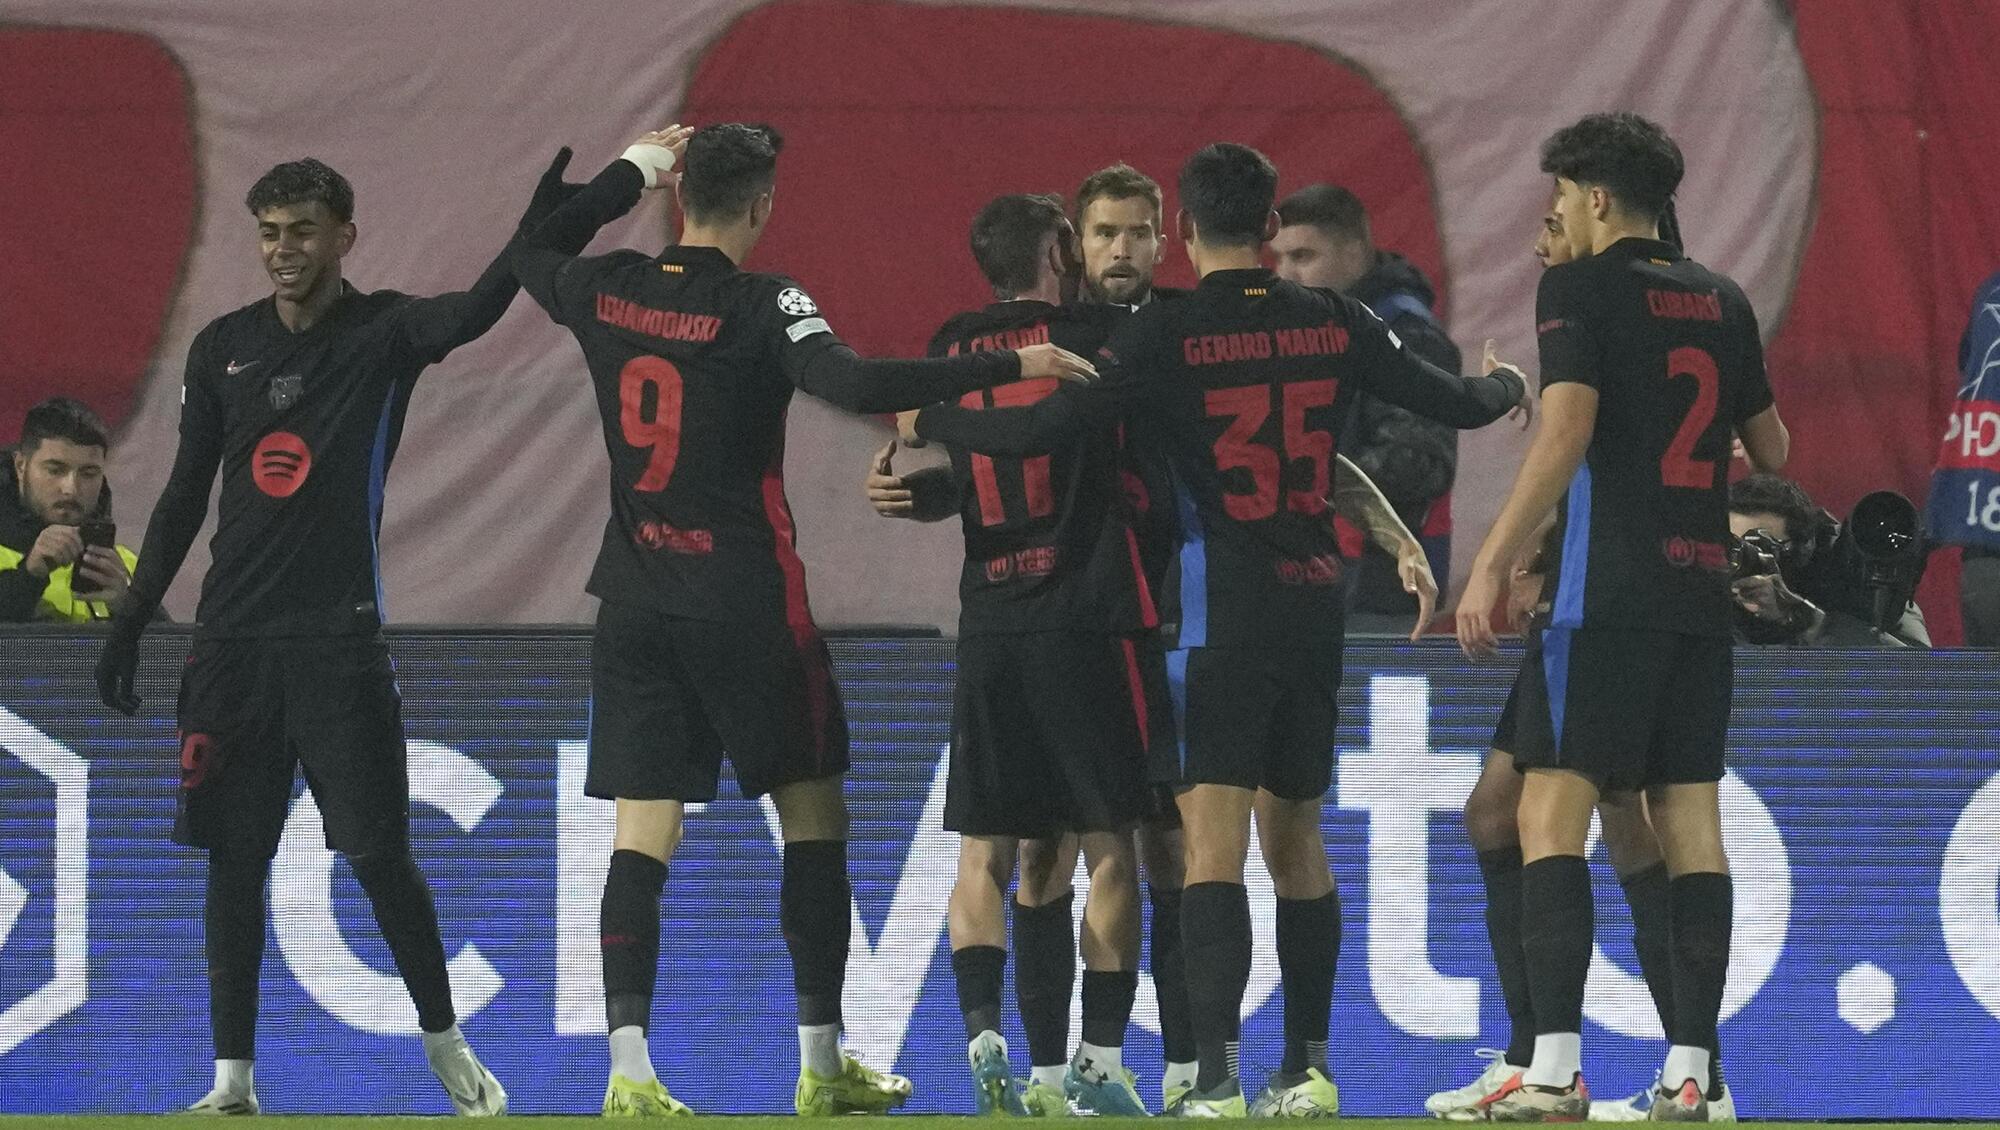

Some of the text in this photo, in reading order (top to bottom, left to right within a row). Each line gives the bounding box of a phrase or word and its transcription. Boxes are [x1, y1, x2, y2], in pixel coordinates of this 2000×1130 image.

[597, 292, 722, 342] LEWANDOWSKI
[1183, 319, 1350, 366] GERARD MARTÍN
[619, 355, 684, 493] 9
[1203, 377, 1340, 521] 35
[1661, 346, 1719, 489] 2
[177, 729, 209, 790] 9
